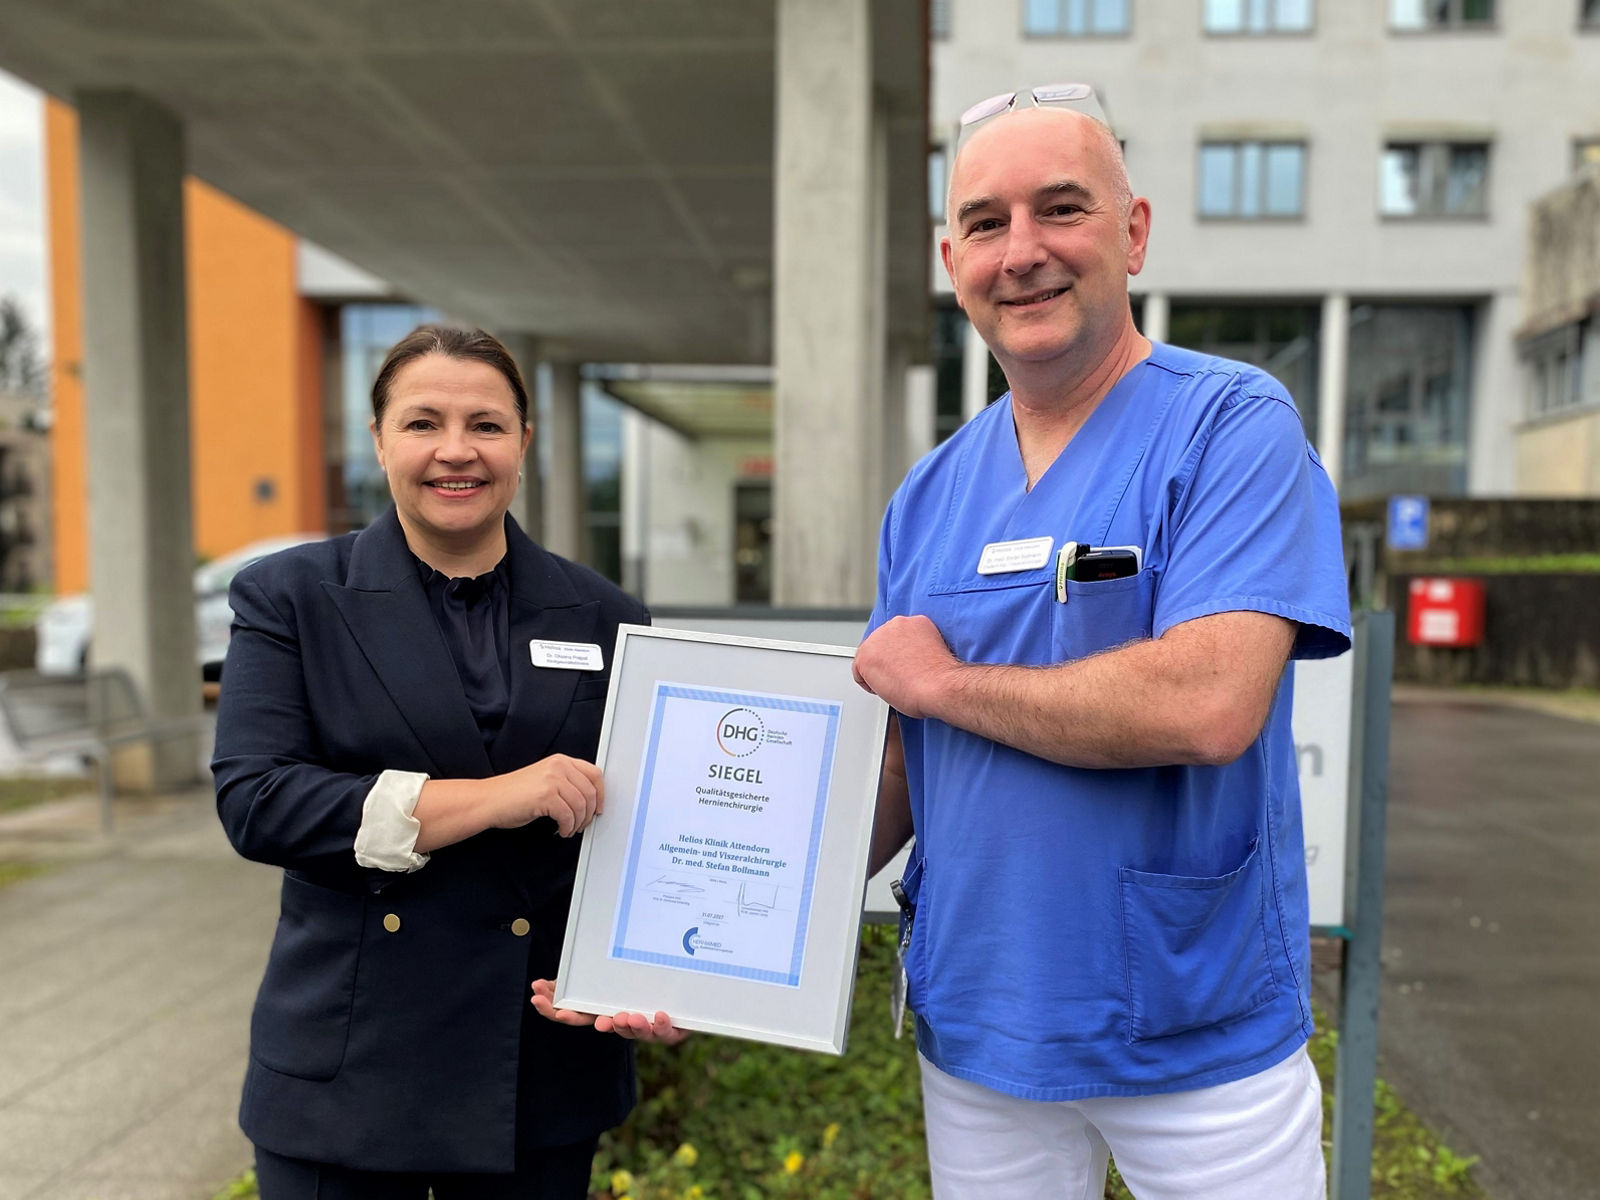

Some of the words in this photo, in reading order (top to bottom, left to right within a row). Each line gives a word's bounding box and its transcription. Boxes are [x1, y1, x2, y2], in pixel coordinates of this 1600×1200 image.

[723, 724, 758, 741] DHG
[708, 764, 763, 784] SIEGEL
[695, 786, 770, 803] Qualitätsgesicherte
[698, 798, 763, 813] Hernienchirurgie
[678, 834, 703, 845] Helios
[704, 838, 728, 849] Klinik
[729, 841, 770, 854] Attendorn
[659, 843, 701, 856] Allgemein-
[702, 850, 718, 859] und
[719, 851, 787, 869] Viszeralchirurgie
[671, 856, 684, 865] Dr.
[685, 859, 704, 868] med.
[705, 861, 730, 872] Stefan
[731, 864, 770, 877] Bollmann
